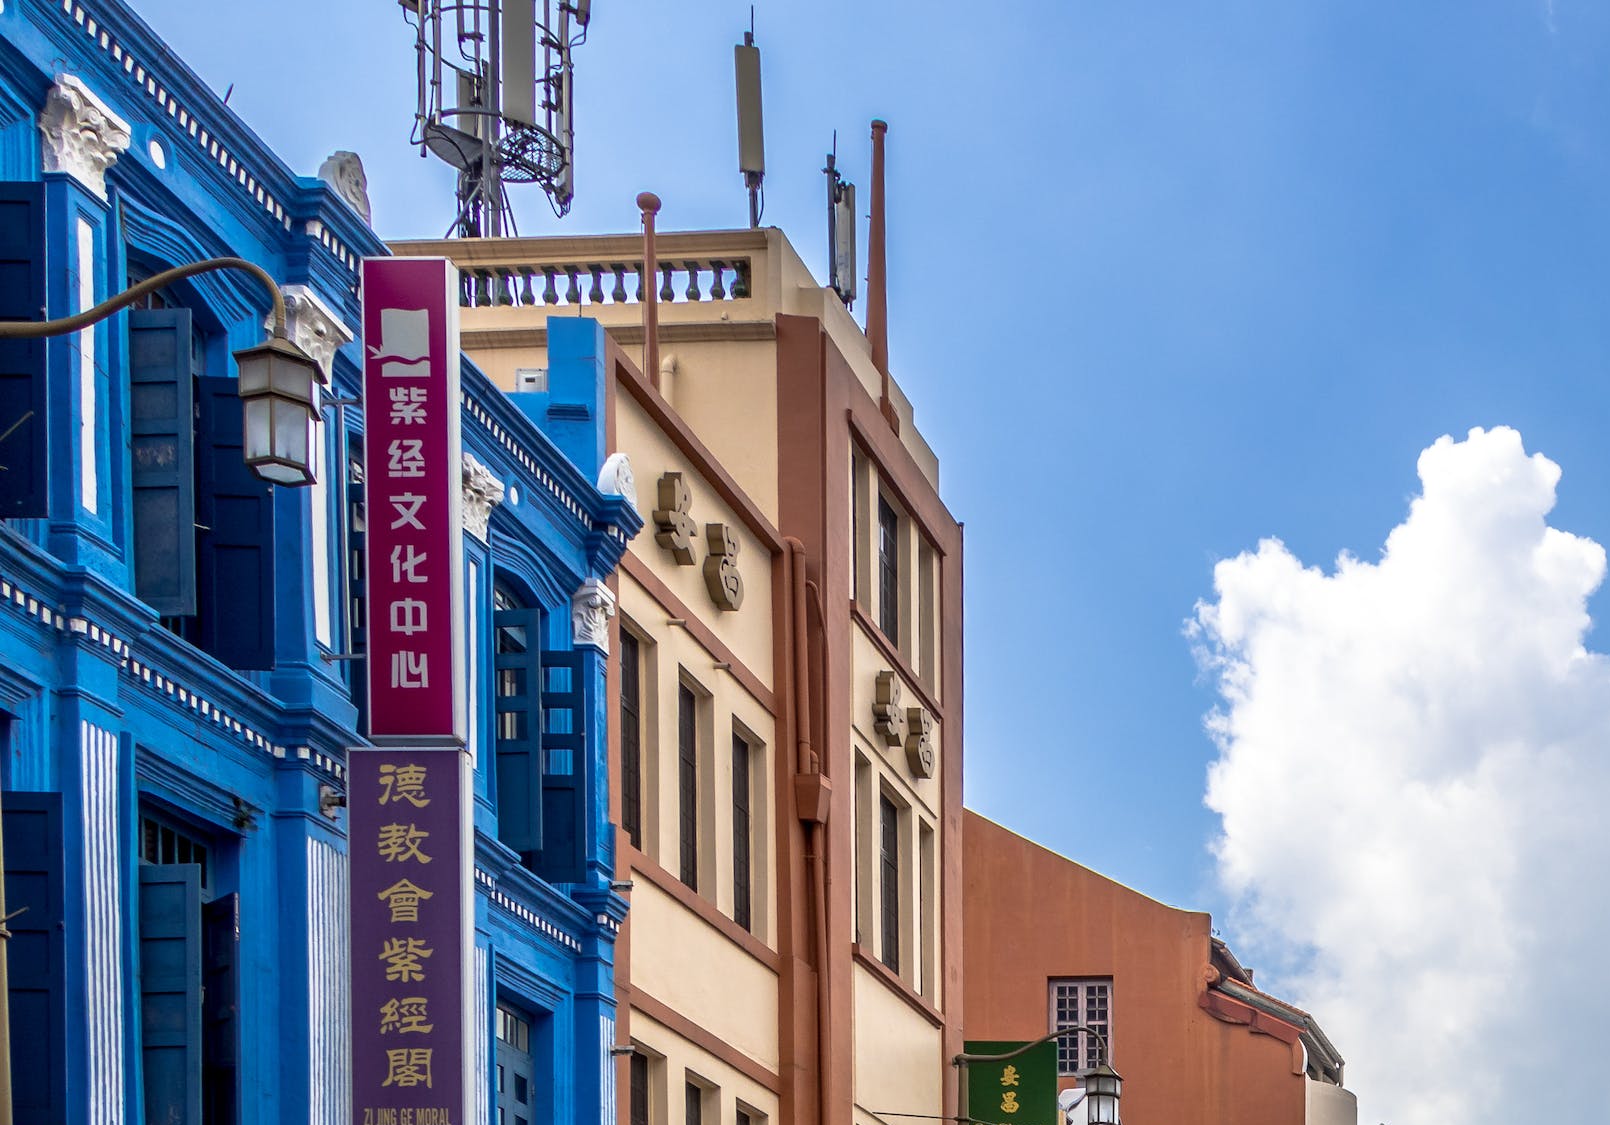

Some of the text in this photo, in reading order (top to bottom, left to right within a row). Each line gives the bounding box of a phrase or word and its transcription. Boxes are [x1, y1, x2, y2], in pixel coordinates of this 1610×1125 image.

[387, 386, 429, 689] 紫经文化中心
[377, 763, 434, 1089] 德教會紫經閣
